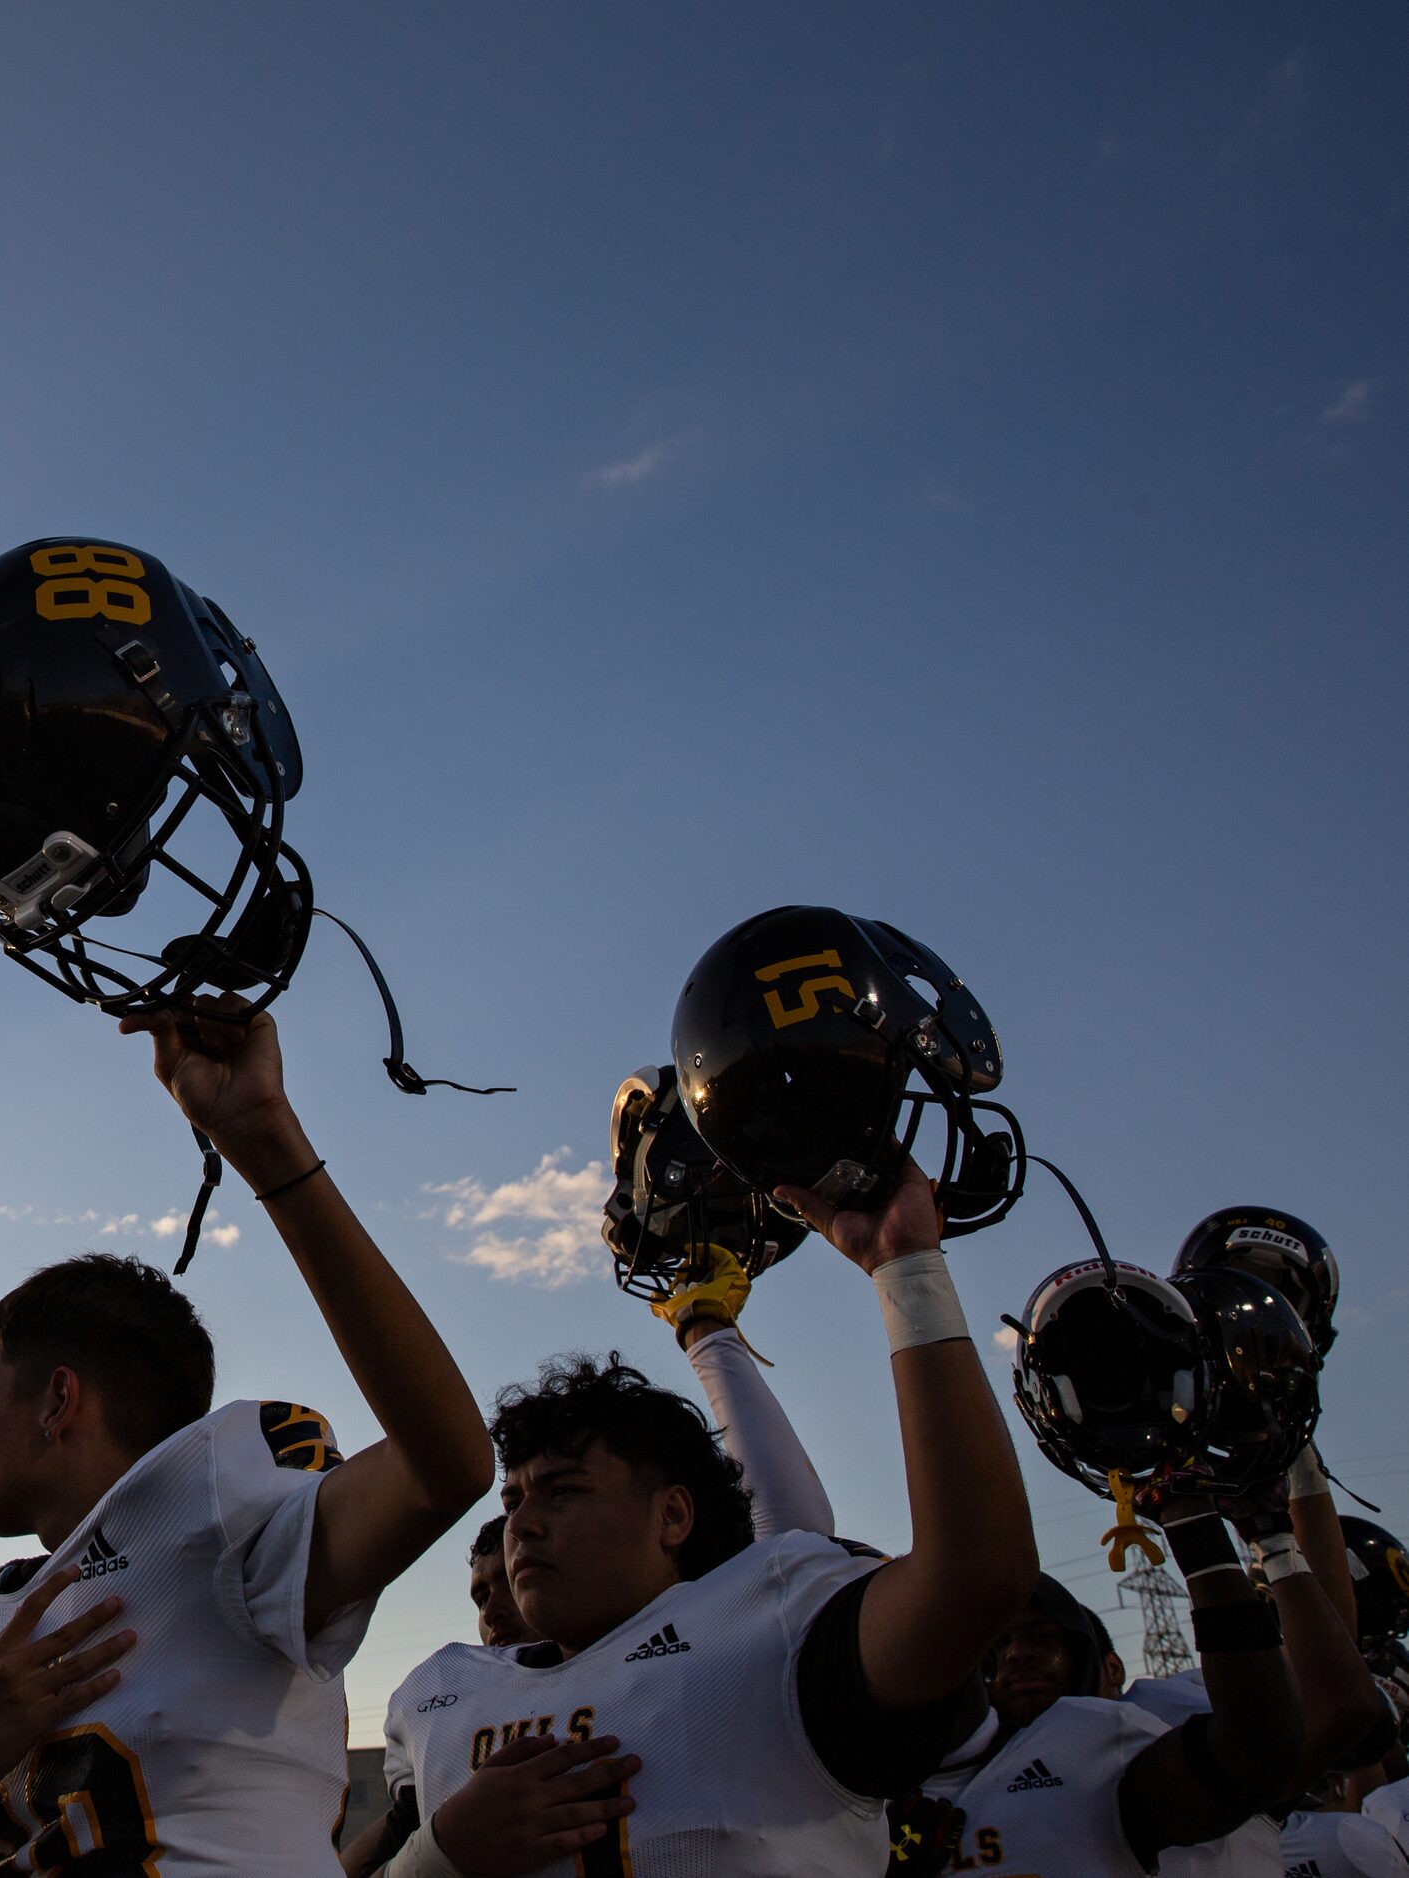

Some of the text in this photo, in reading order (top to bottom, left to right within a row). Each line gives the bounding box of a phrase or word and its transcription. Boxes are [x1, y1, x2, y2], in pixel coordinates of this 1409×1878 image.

[29, 544, 152, 626] 88
[16, 862, 52, 893] schutt
[754, 948, 857, 1030] 15
[1238, 1228, 1302, 1251] schutt
[624, 1641, 691, 1662] adidas
[1006, 1776, 1064, 1793] adidas
